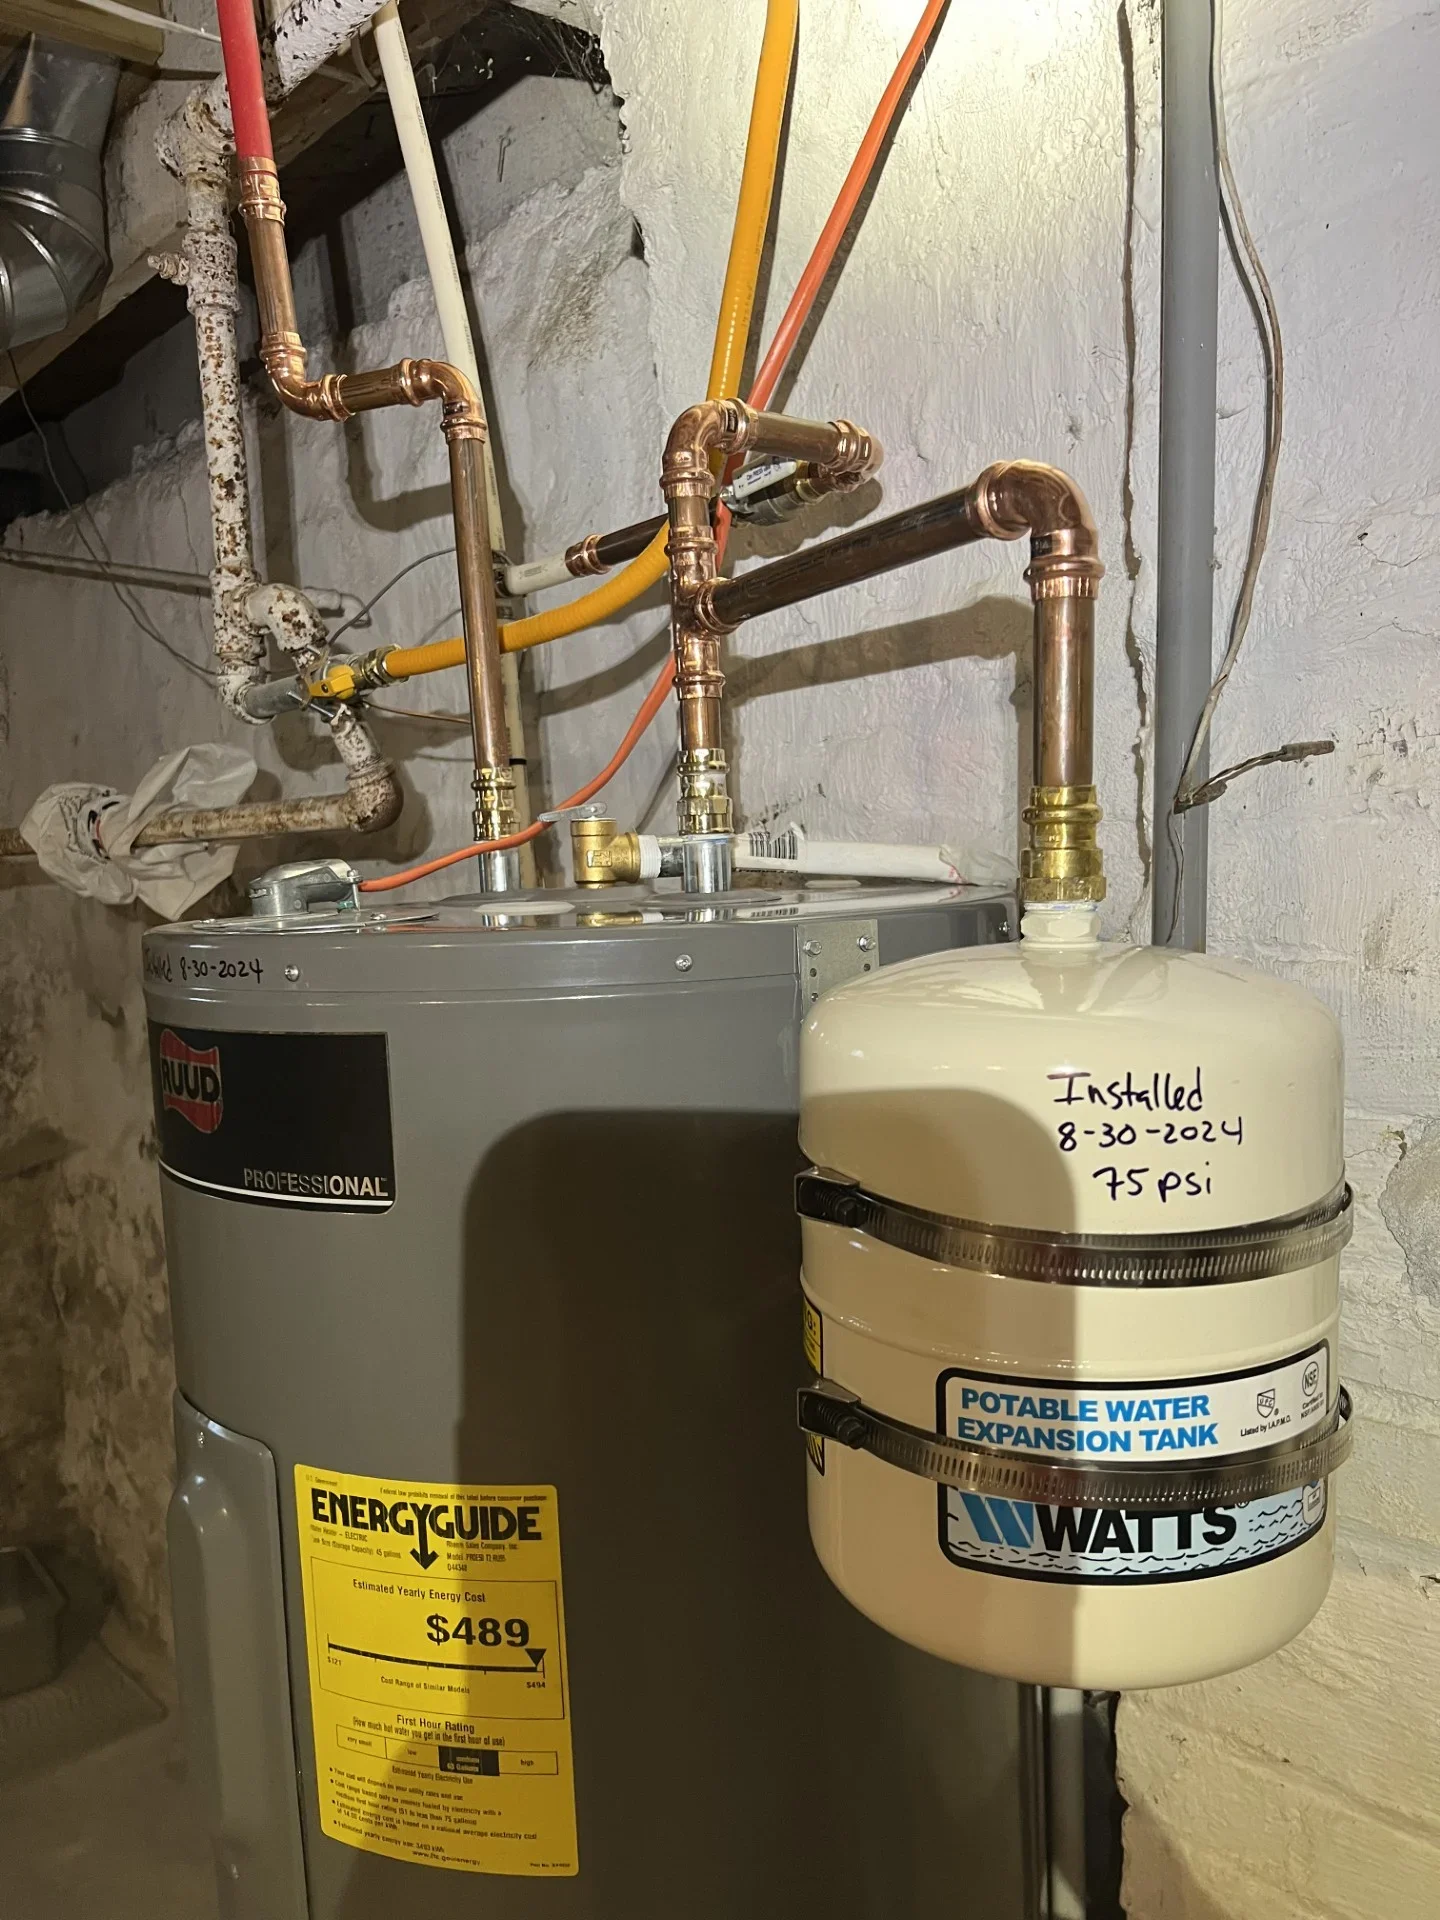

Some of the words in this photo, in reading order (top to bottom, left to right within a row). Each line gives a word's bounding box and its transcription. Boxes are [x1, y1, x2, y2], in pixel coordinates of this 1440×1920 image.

[180, 956, 263, 984] 8-30-2024
[161, 1057, 220, 1103] RUUD
[1047, 1066, 1203, 1112] Installed
[1058, 1116, 1242, 1151] 8-30-2024
[243, 1167, 389, 1197] PROFESSIONAL
[1092, 1166, 1149, 1201] 75
[1158, 1161, 1211, 1203] psi
[1304, 1368, 1317, 1390] NSF
[961, 1387, 1098, 1422] POTABLE
[1105, 1394, 1211, 1422] WATER
[957, 1417, 1131, 1452] EXPANSION
[1139, 1422, 1219, 1451] TANK
[1240, 1426, 1259, 1437] Listed
[1260, 1423, 1267, 1433] by
[310, 1487, 542, 1541] ENERGYGUIDE
[1035, 1500, 1238, 1554] WATTS
[345, 1531, 368, 1542] ELECTRIC
[353, 1578, 394, 1595] Estimated
[397, 1584, 426, 1600] Yearly
[429, 1589, 461, 1603] Energy
[464, 1591, 486, 1603] Cost
[426, 1613, 529, 1647] $489
[327, 1655, 342, 1667] $121
[380, 1676, 394, 1686] Cost
[395, 1678, 415, 1690] Range
[415, 1681, 422, 1690] of
[423, 1682, 446, 1693] Similar
[447, 1684, 470, 1695] Models
[367, 1720, 382, 1731] much
[383, 1723, 393, 1733] hot
[394, 1725, 410, 1736] water
[411, 1729, 422, 1739] you
[423, 1730, 433, 1741] get
[435, 1730, 440, 1740] in
[442, 1731, 452, 1742] the
[453, 1732, 466, 1743] first
[467, 1733, 481, 1744] hour
[483, 1734, 490, 1745] of
[492, 1736, 505, 1747] use)
[396, 1714, 417, 1727] First
[419, 1717, 441, 1730] Hour
[445, 1721, 475, 1735] Rating
[520, 1758, 534, 1767] high
[408, 1786, 424, 1796] utility
[418, 1771, 434, 1781] Yearly
[435, 1773, 461, 1784] Electricity
[463, 1776, 473, 1785] Use
[445, 1815, 452, 1823] 75
[490, 1831, 522, 1840] electricity
